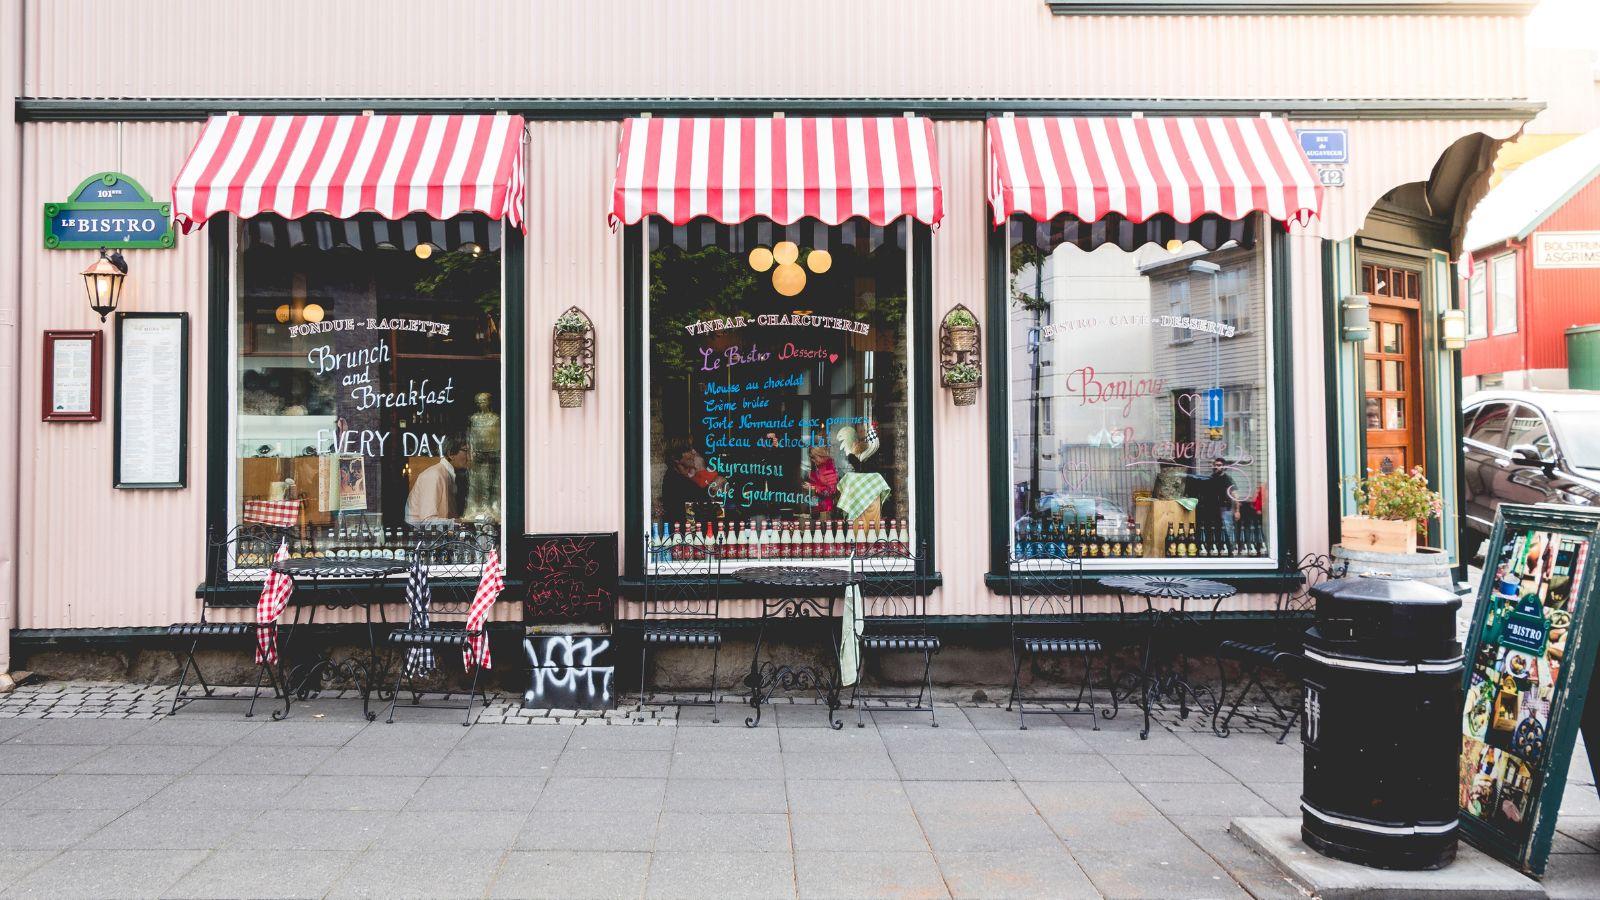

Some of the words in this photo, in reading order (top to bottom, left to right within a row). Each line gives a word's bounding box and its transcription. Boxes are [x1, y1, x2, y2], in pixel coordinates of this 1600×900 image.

[1322, 171, 1341, 184] 12
[61, 219, 76, 227] LE
[77, 218, 156, 232] BISTRO
[288, 318, 355, 338] FONDUE
[366, 318, 450, 336] RACLETTE
[685, 316, 747, 336] VÍNBAR
[757, 314, 870, 336] CHARCUTERIE
[1043, 318, 1097, 338] BISTRO
[1160, 315, 1236, 338] DESSERTS
[307, 338, 391, 376] Brunch
[699, 347, 721, 371] Le
[724, 343, 771, 367] Bistro
[778, 342, 828, 361] Desserts
[342, 365, 371, 386] and
[704, 381, 741, 396] Mousse
[745, 381, 759, 391] au
[763, 373, 804, 388] chocolat
[351, 377, 454, 416] Breakfast
[1066, 366, 1168, 418] Bonjour
[703, 400, 737, 413] Crème
[739, 413, 795, 430] Normande
[798, 417, 820, 428] aux
[826, 415, 870, 435] pommes
[316, 429, 391, 457] EVERY
[402, 431, 447, 458] DAY
[756, 436, 774, 448] au
[778, 429, 832, 448] chocolat
[707, 482, 735, 507] Café
[1512, 624, 1542, 641] BISTRO
